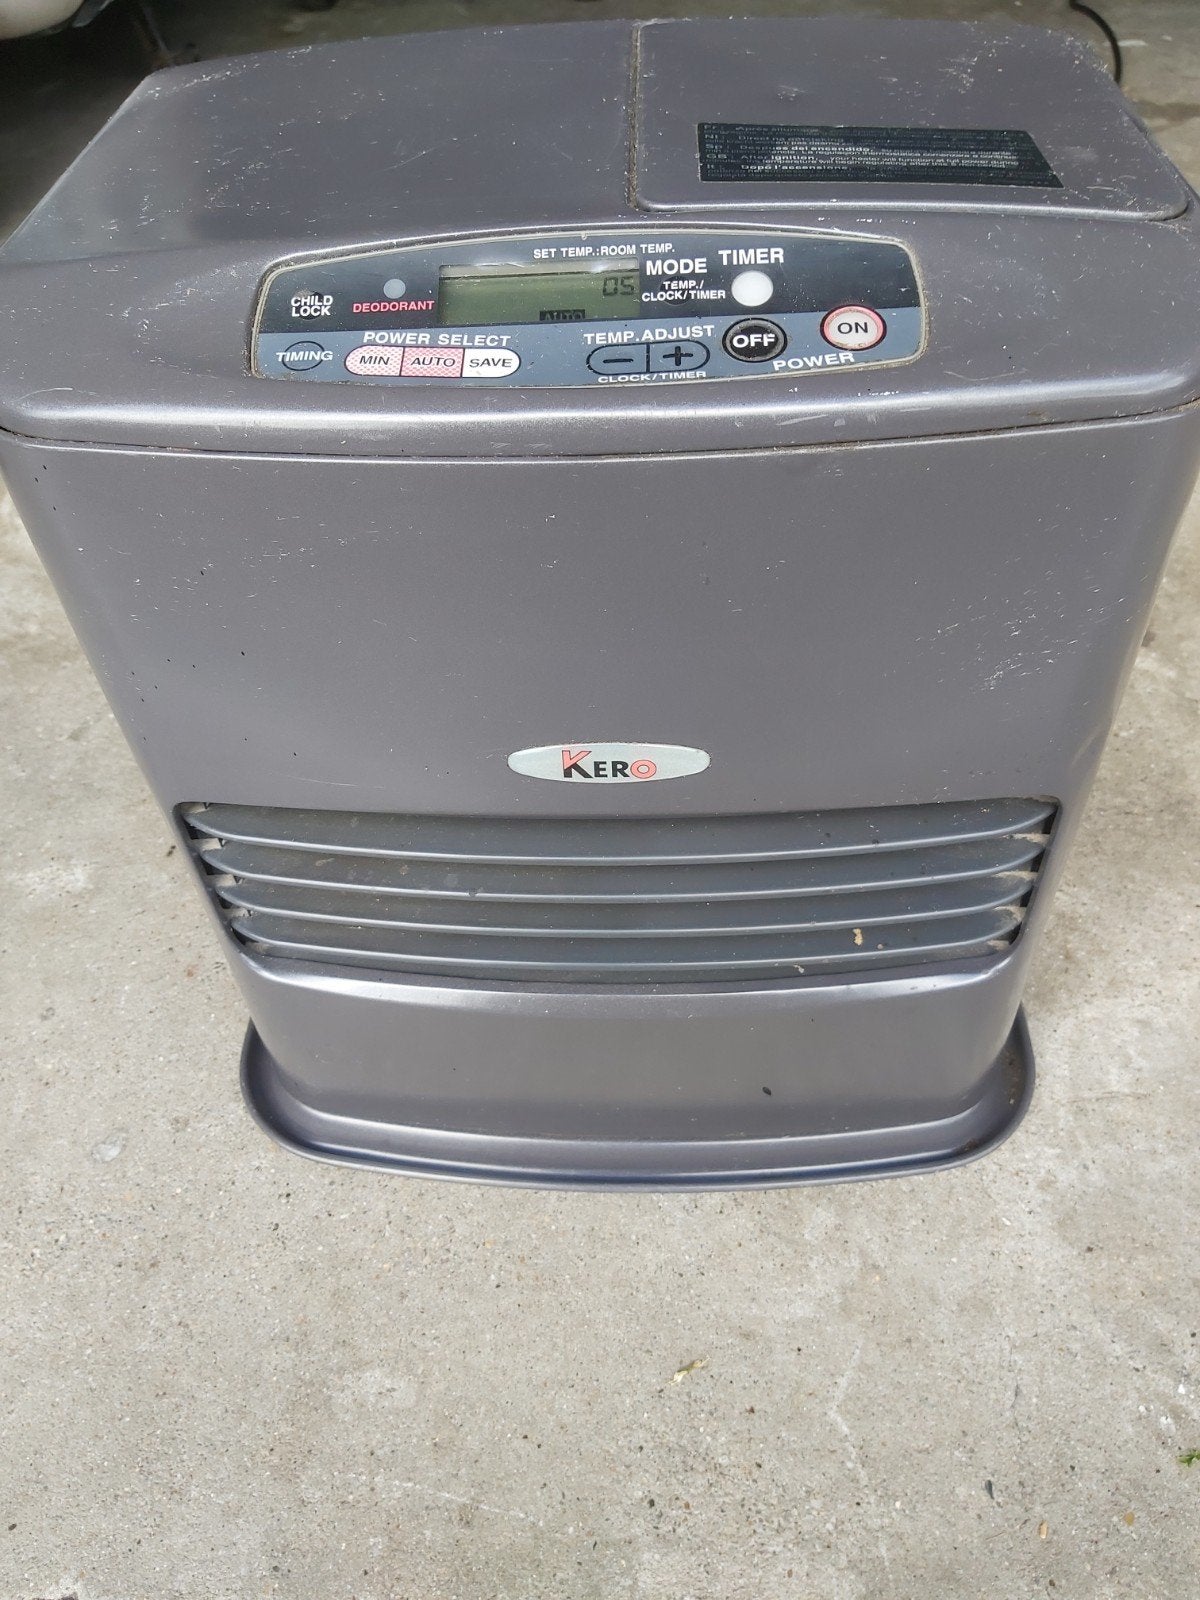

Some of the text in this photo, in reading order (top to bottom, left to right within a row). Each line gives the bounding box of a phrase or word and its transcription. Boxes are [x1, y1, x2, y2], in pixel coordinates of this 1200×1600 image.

[533, 248, 557, 259] SET
[640, 243, 675, 254] TEMP.
[718, 247, 784, 266] TIMER
[646, 257, 708, 275] MODE
[663, 280, 704, 290] TEMP./
[291, 295, 334, 307] CHILD
[641, 290, 726, 302] CLOCK/TIMER
[292, 305, 331, 317] LOCK
[353, 300, 435, 313] DEODORANT
[837, 322, 869, 334] ON
[363, 331, 511, 347] POWER SELECT
[732, 333, 776, 348] OFF
[276, 350, 334, 362] TIMING
[359, 355, 390, 366] MIN
[410, 357, 456, 367] AUTO
[773, 351, 856, 371] POWER
[469, 358, 513, 369] SAVE
[597, 370, 707, 383] CLOCK/TIMER
[561, 749, 657, 779] KERO
